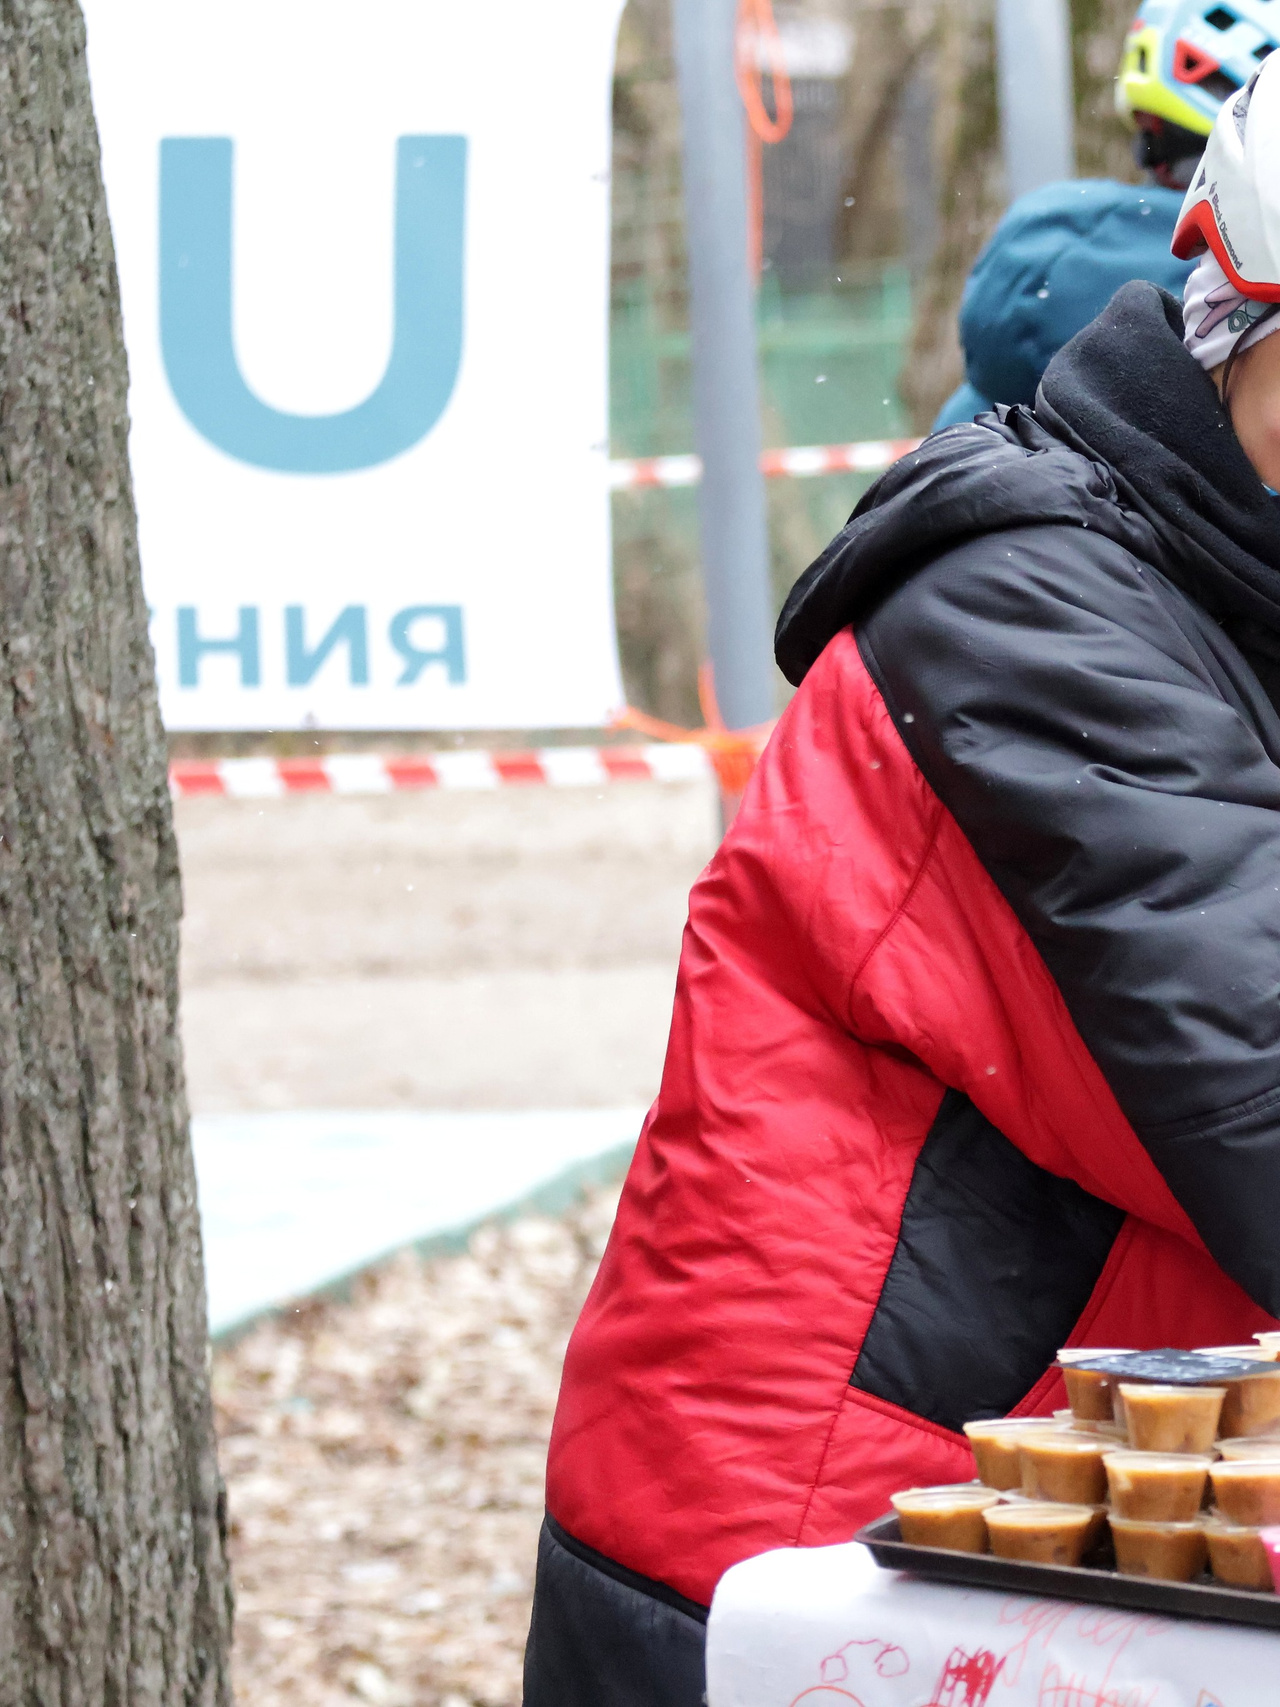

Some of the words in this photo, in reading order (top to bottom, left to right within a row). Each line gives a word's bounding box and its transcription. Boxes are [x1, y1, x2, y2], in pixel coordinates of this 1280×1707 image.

[1212, 193, 1223, 222] Black
[1219, 221, 1243, 270] Diamond
[157, 133, 469, 476] U
[147, 602, 467, 688] НИЯ
